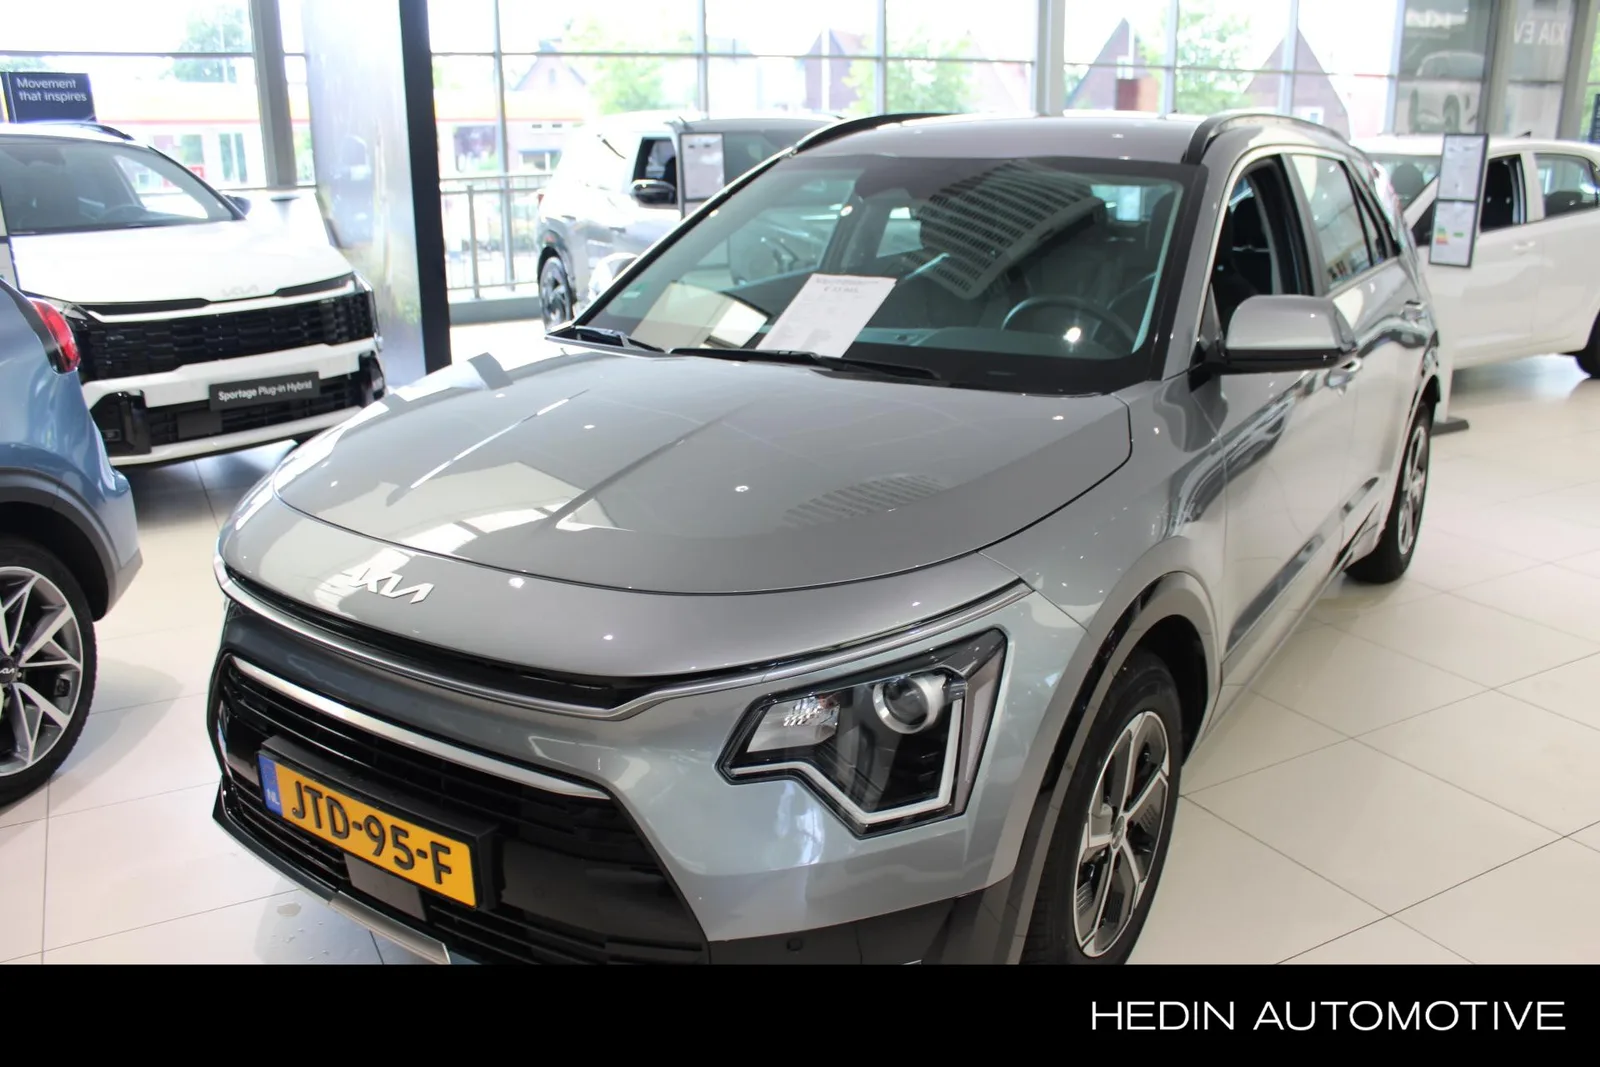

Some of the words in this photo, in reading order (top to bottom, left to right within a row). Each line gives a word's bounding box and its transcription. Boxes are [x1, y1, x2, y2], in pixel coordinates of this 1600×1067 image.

[16, 77, 77, 89] Movement
[19, 91, 42, 102] that
[43, 91, 88, 104] inspires
[218, 388, 258, 402] Sportage
[258, 384, 286, 396] Plug-in
[287, 380, 313, 393] Hybrid
[266, 788, 280, 806] NL
[291, 780, 453, 885] JTD-95-F
